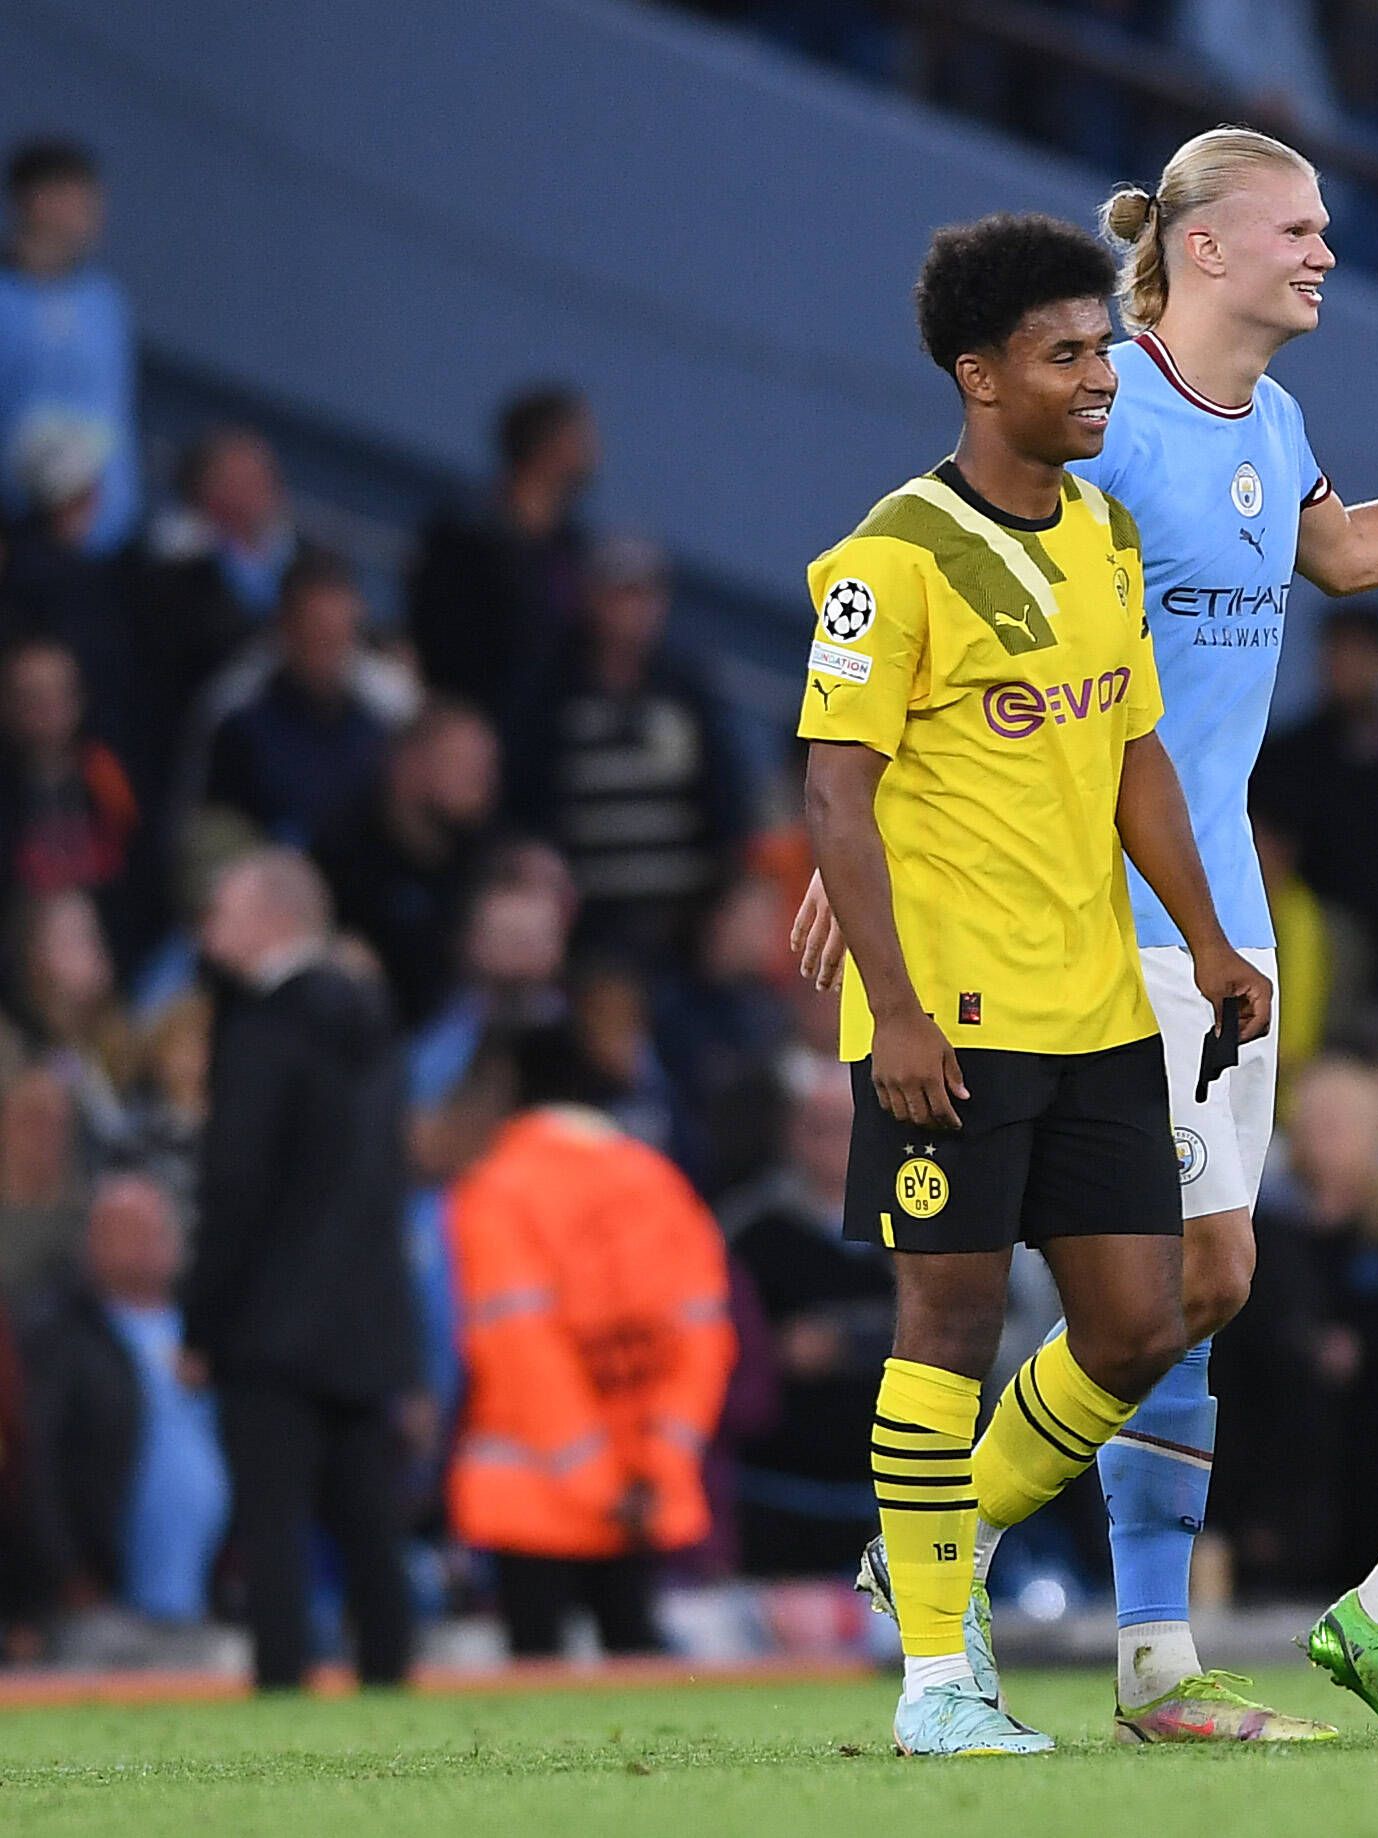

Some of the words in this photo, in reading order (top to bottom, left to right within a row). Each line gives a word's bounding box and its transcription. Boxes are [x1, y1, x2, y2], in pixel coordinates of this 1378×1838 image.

[1193, 627, 1280, 647] AIRWAYS
[904, 1165, 941, 1200] BVB
[915, 1199, 929, 1211] 09
[933, 1543, 958, 1561] 19
